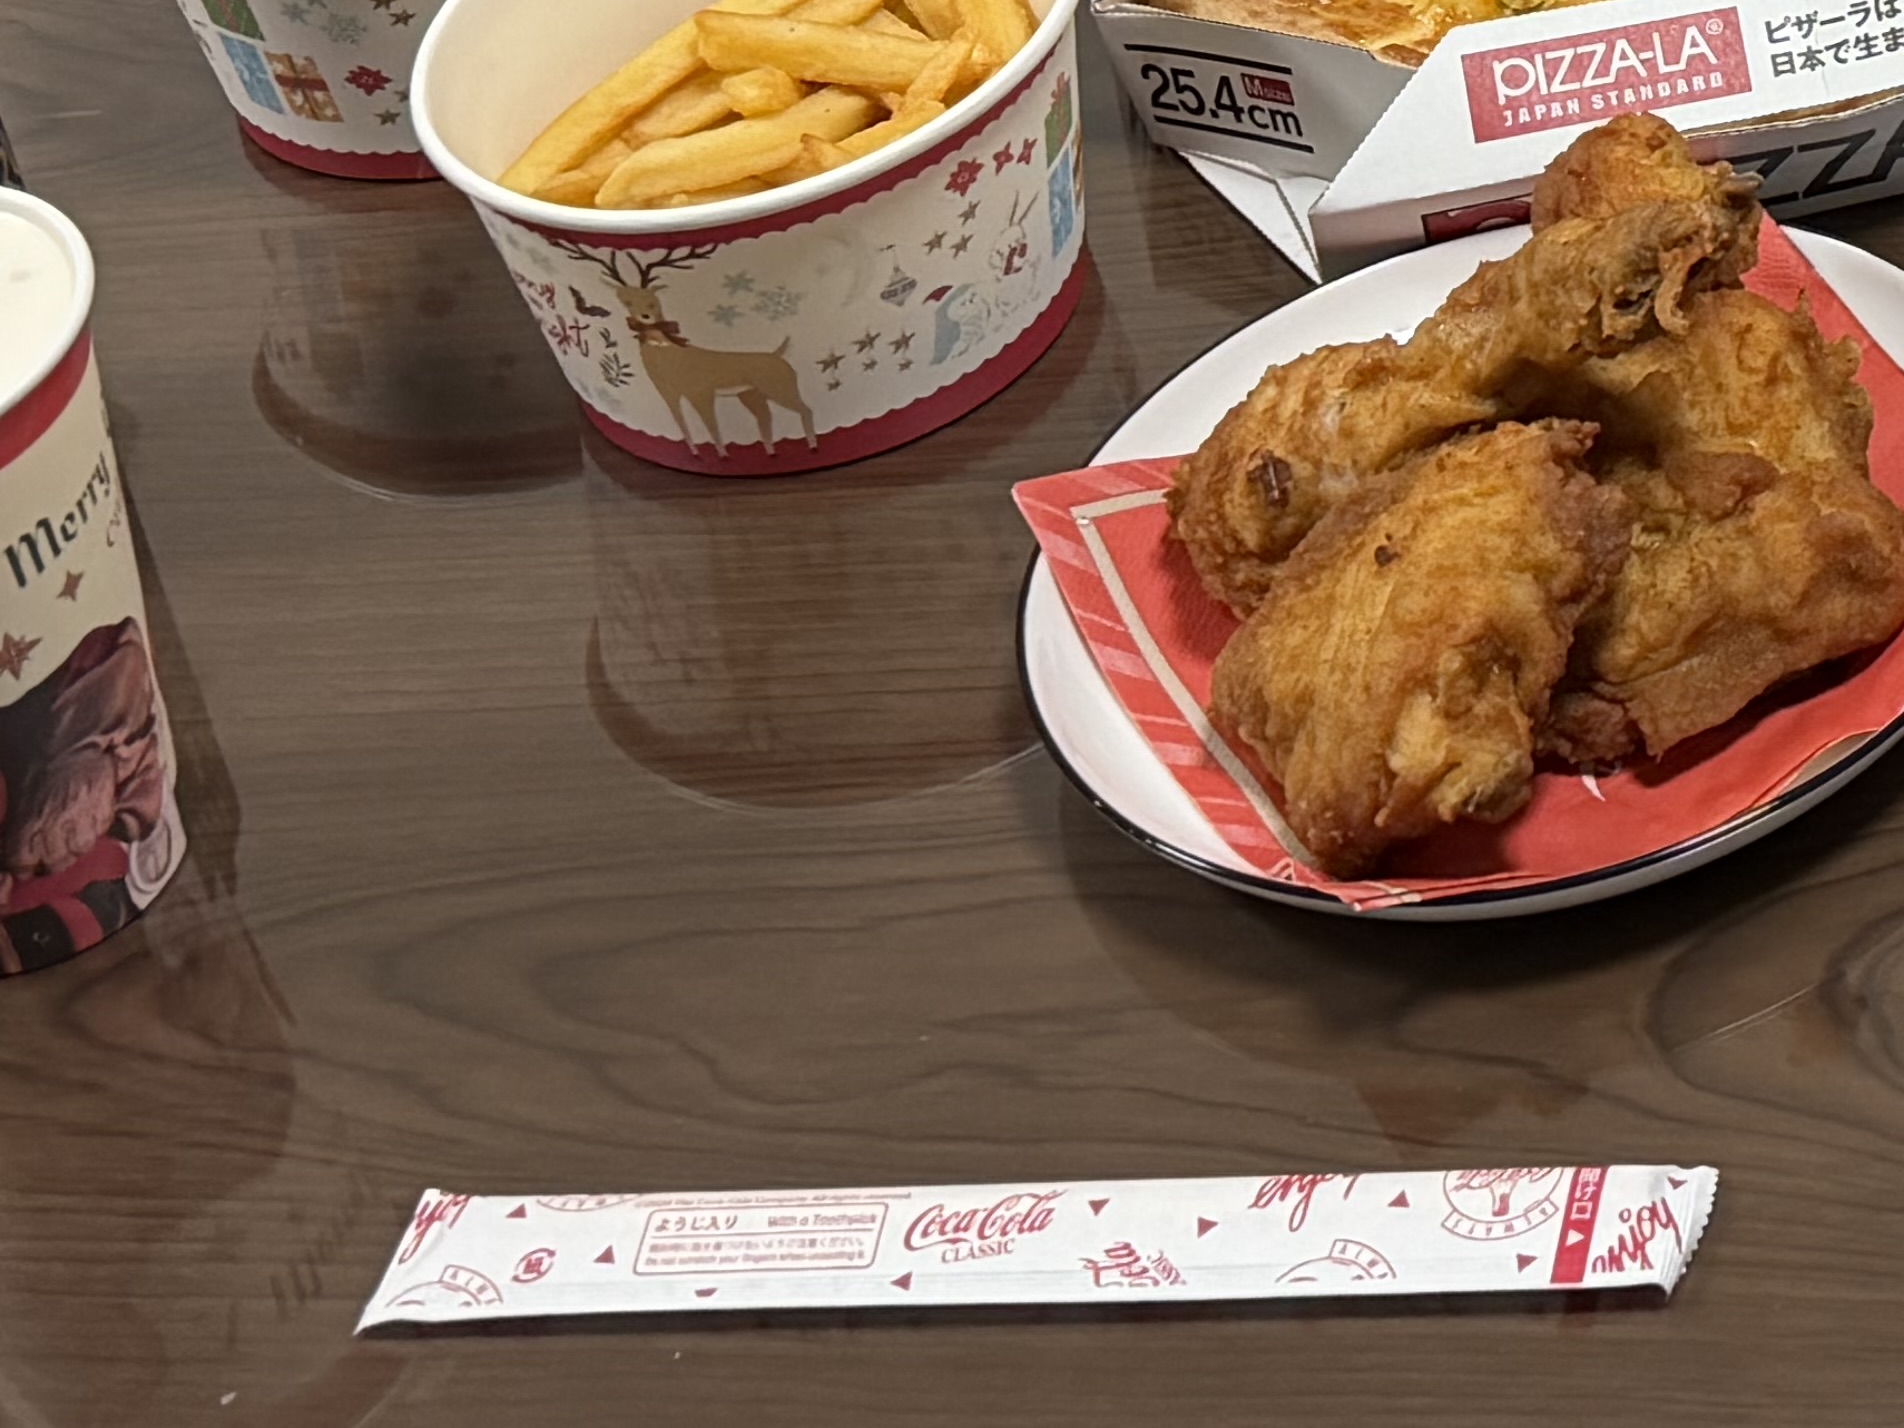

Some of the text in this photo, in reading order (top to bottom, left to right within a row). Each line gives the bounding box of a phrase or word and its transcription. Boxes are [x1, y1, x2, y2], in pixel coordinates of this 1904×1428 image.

[1503, 69, 1725, 128] JAPAN STANDARD
[3, 450, 110, 589] Merry
[654, 1214, 738, 1232] ようじ入り
[904, 1188, 1068, 1248] Coca-Cola
[940, 1237, 1016, 1263] CLASSIC
